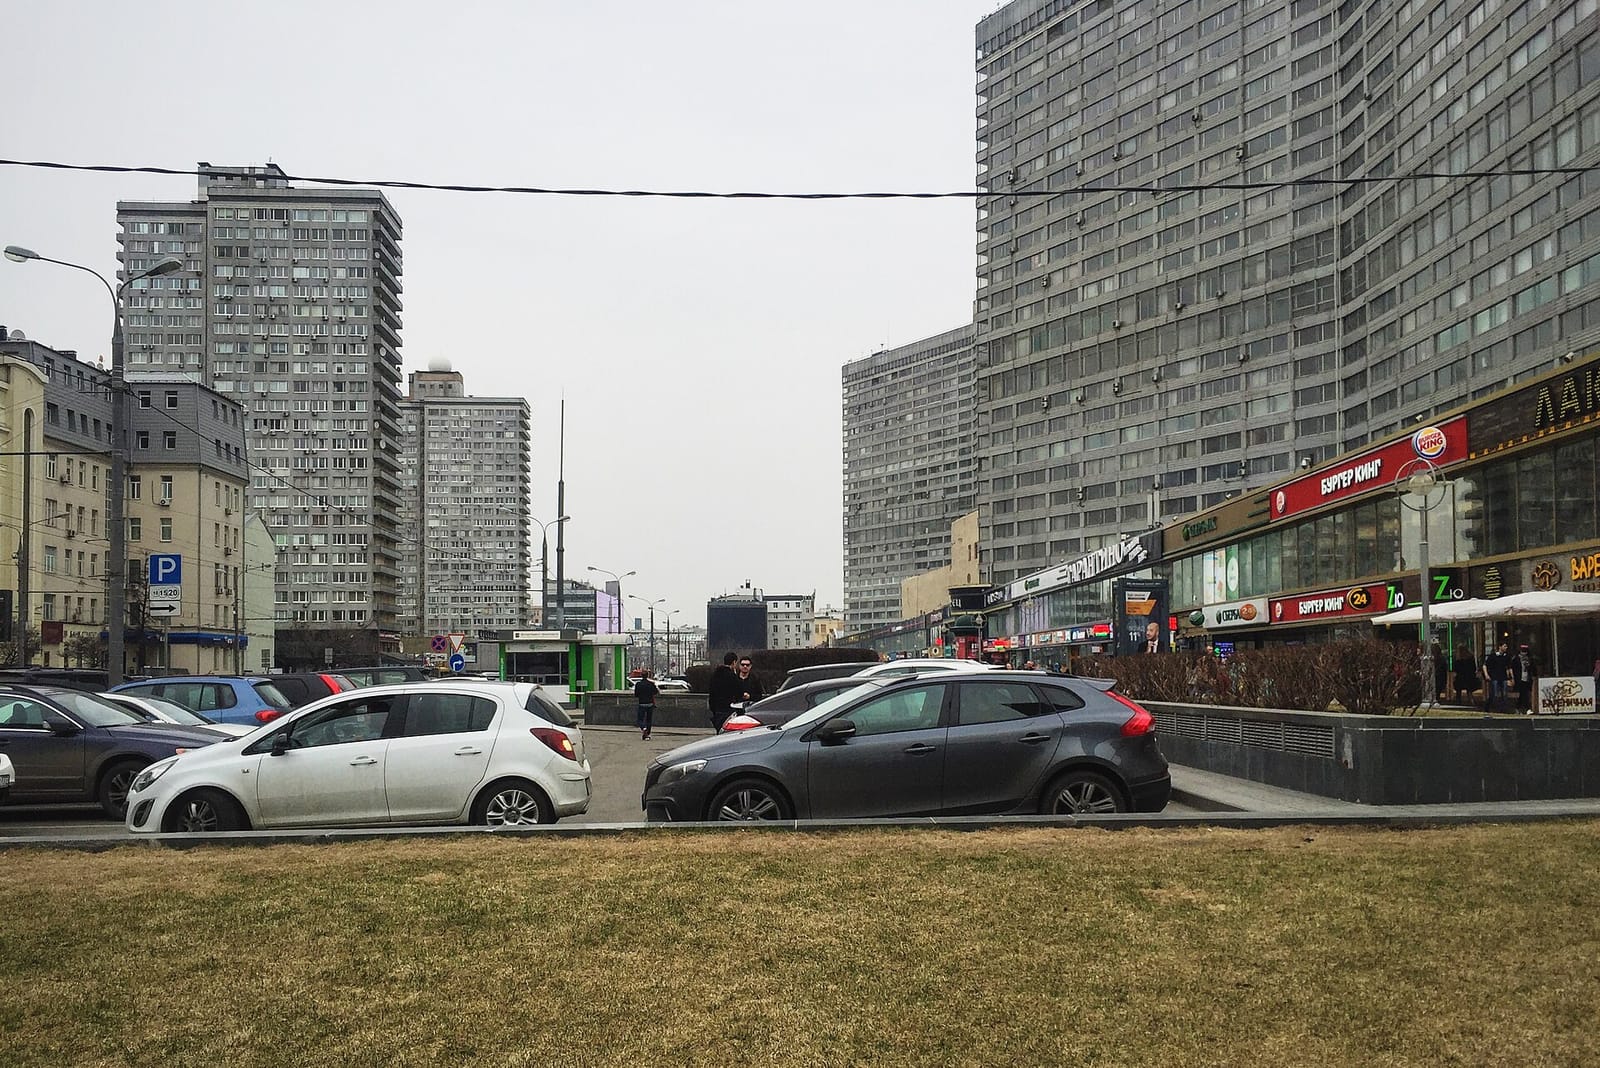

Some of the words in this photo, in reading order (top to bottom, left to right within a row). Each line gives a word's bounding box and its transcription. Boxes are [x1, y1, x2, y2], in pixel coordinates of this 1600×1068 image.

[1419, 432, 1441, 444] BURGER
[1420, 438, 1443, 451] KING
[1321, 468, 1354, 495] БУРГЕР
[1354, 458, 1382, 484] КИНГ
[158, 557, 177, 581] P
[1299, 600, 1324, 615] БУРГЕР
[1324, 597, 1344, 612] КИНГ
[1353, 593, 1367, 604] 24
